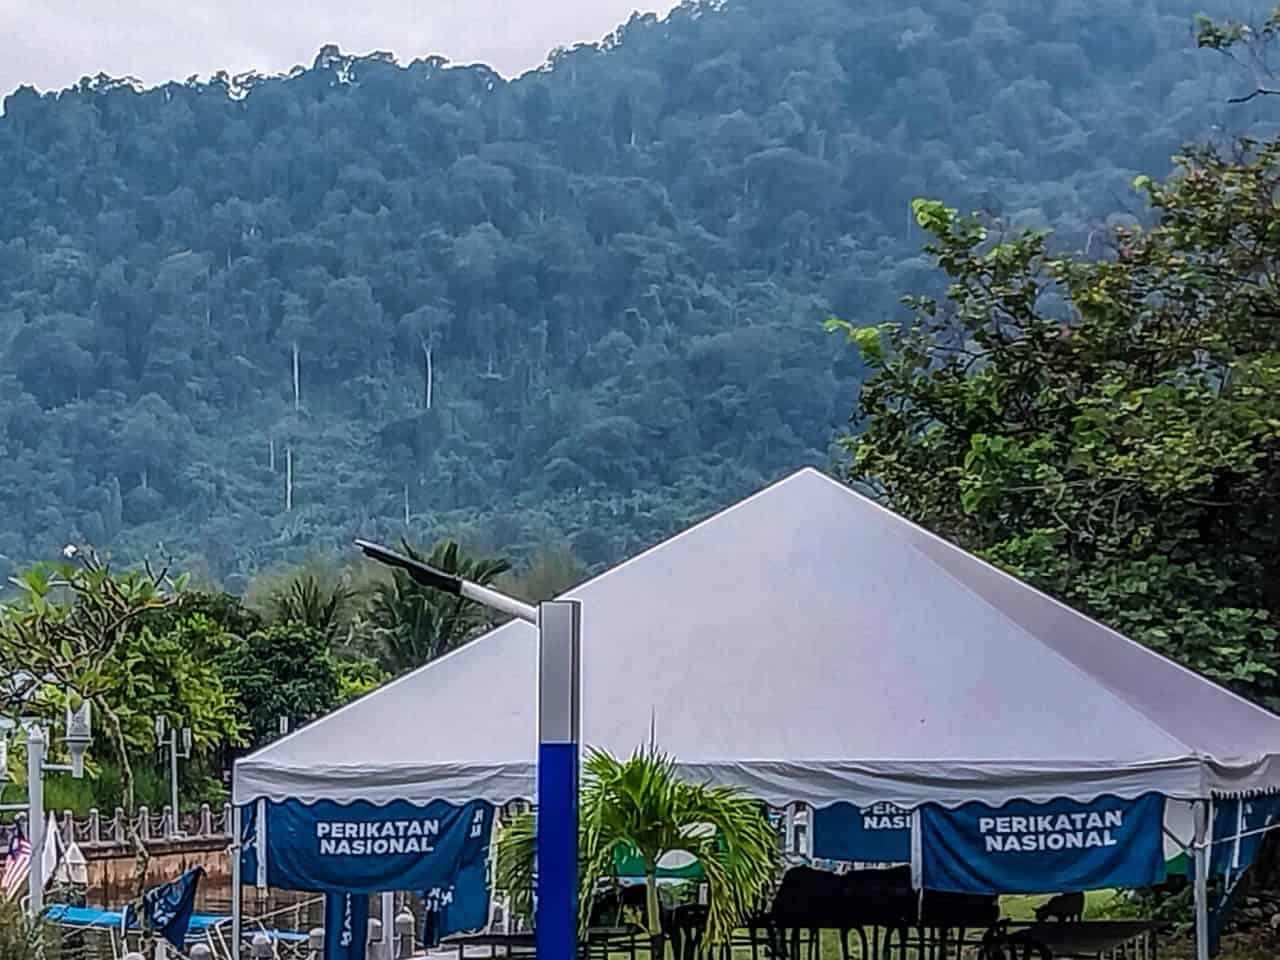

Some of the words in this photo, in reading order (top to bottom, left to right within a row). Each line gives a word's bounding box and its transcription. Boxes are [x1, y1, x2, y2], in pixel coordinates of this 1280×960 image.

[316, 819, 439, 838] PERIKATAN
[863, 816, 912, 829] NASI
[979, 810, 1123, 833] PERIKATAN
[320, 836, 434, 855] NASIONAL
[985, 829, 1118, 852] NASIONAL
